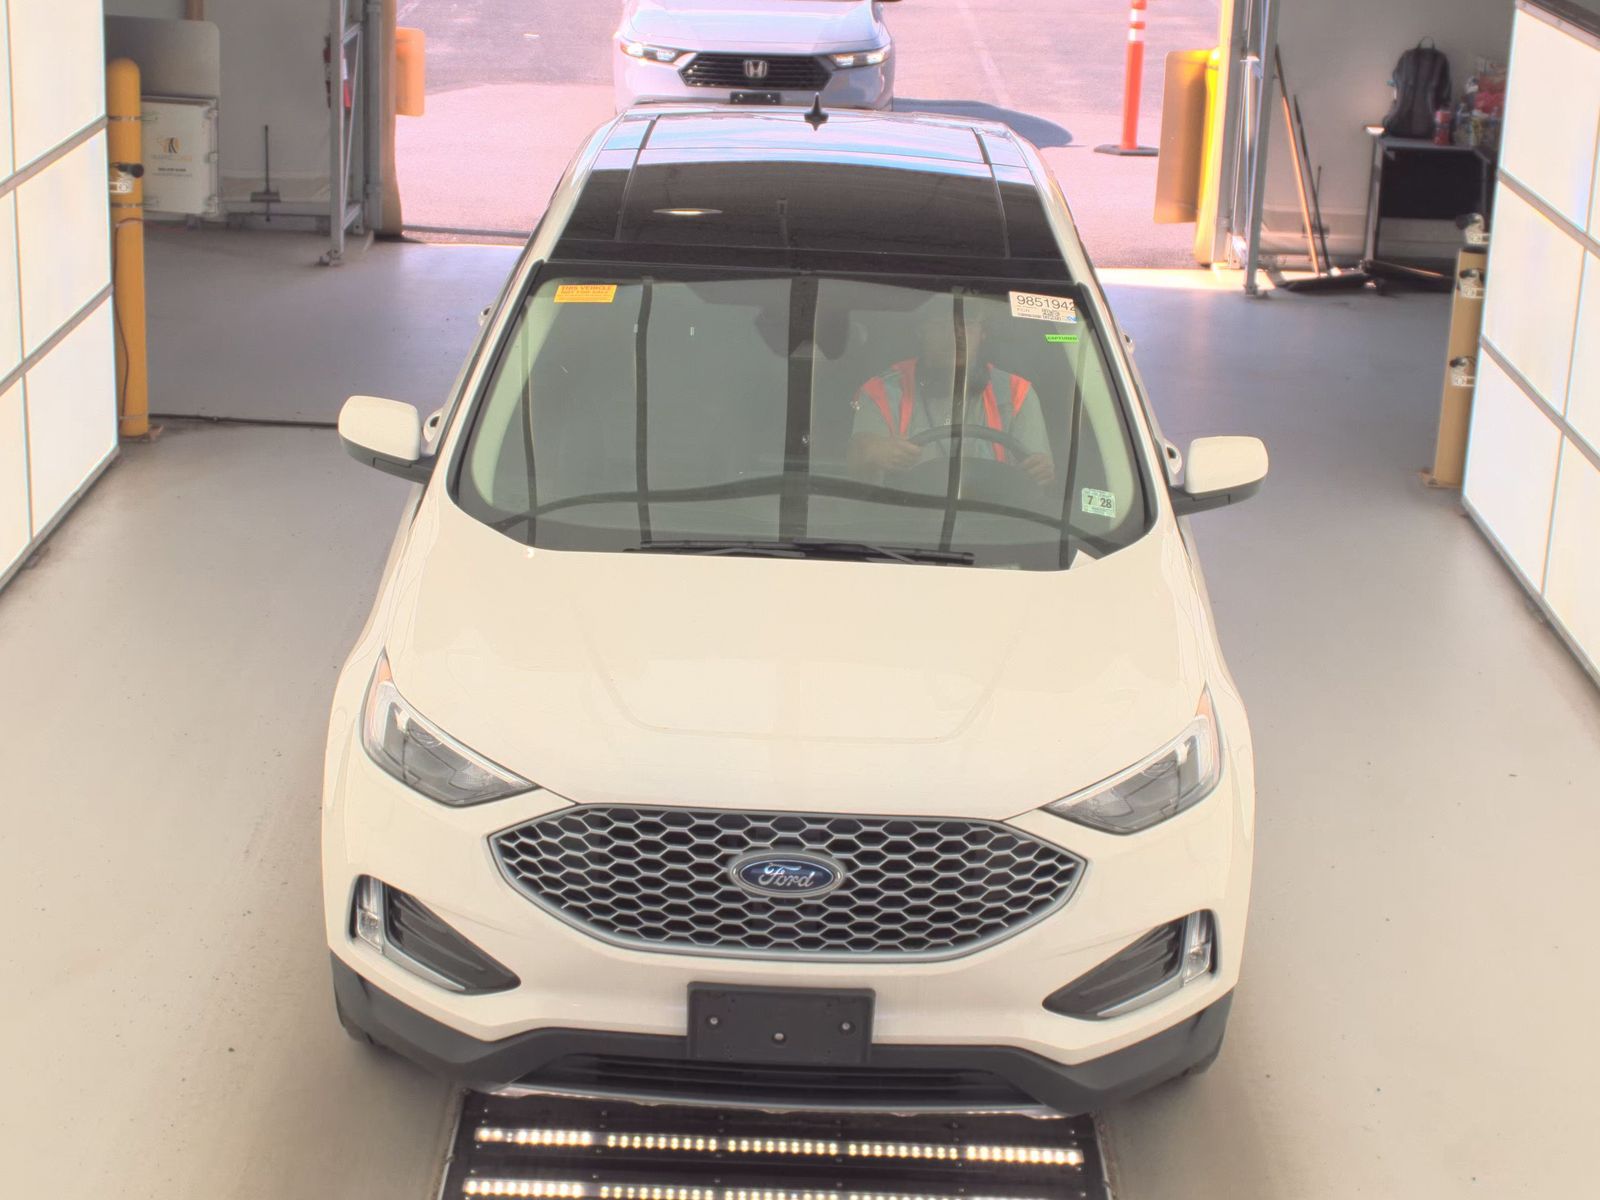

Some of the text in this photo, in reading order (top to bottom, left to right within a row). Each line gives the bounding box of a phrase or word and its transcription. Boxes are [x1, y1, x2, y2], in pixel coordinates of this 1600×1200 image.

[1016, 295, 1076, 311] 9851942
[1087, 495, 1112, 508] 7 28
[758, 863, 815, 887] Ford
